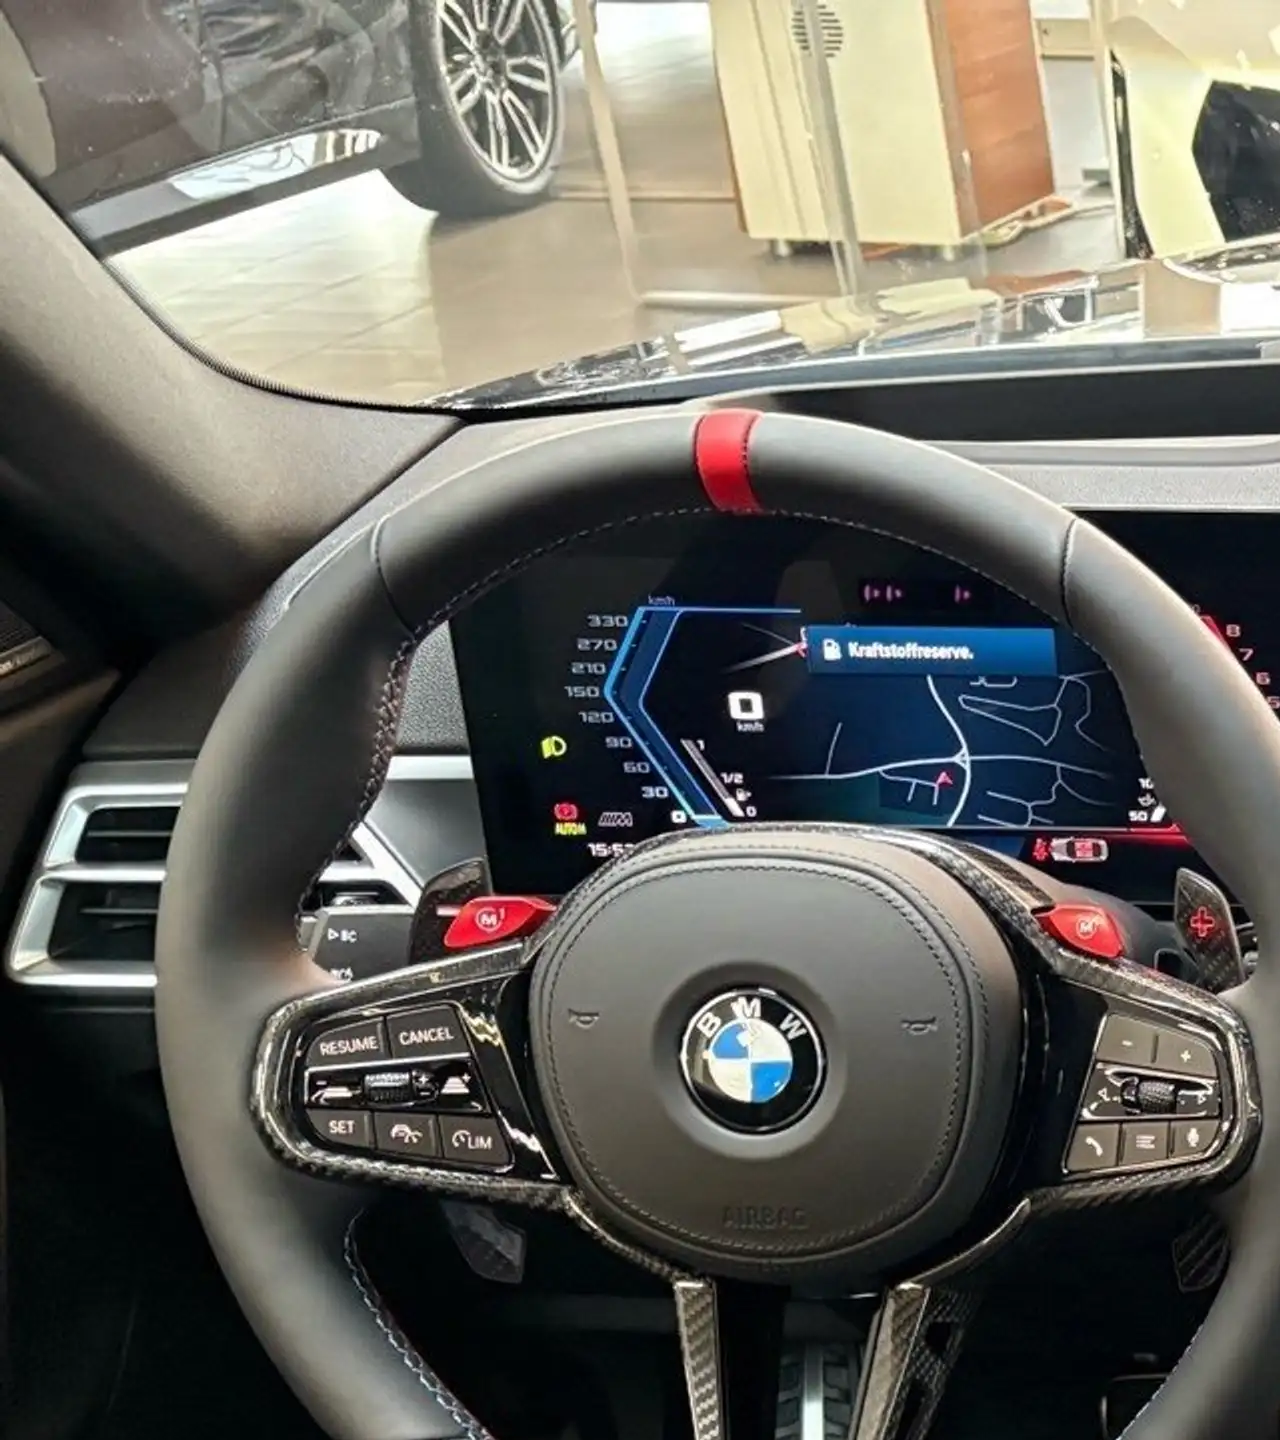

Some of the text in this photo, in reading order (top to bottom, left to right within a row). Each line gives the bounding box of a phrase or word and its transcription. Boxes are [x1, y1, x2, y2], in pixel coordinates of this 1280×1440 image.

[587, 614, 629, 628] 330
[577, 638, 618, 651] 270
[848, 641, 975, 660] Kraftstoffreserve.
[1239, 648, 1254, 661] 7
[571, 662, 606, 675] 210
[1256, 672, 1271, 686] 6
[564, 686, 600, 698] 150
[728, 691, 764, 720] 0
[1266, 696, 1280, 709] 5
[578, 711, 615, 724] 120
[605, 736, 633, 749] 90
[623, 762, 650, 774] 60
[720, 772, 744, 784] 1/2
[641, 786, 669, 799] 30
[746, 806, 757, 818] 0
[696, 997, 806, 1041] BMW
[399, 1027, 455, 1046] CANCEL
[319, 1036, 380, 1056] RESUME
[328, 1120, 356, 1135] SET
[467, 1135, 493, 1150] LIM
